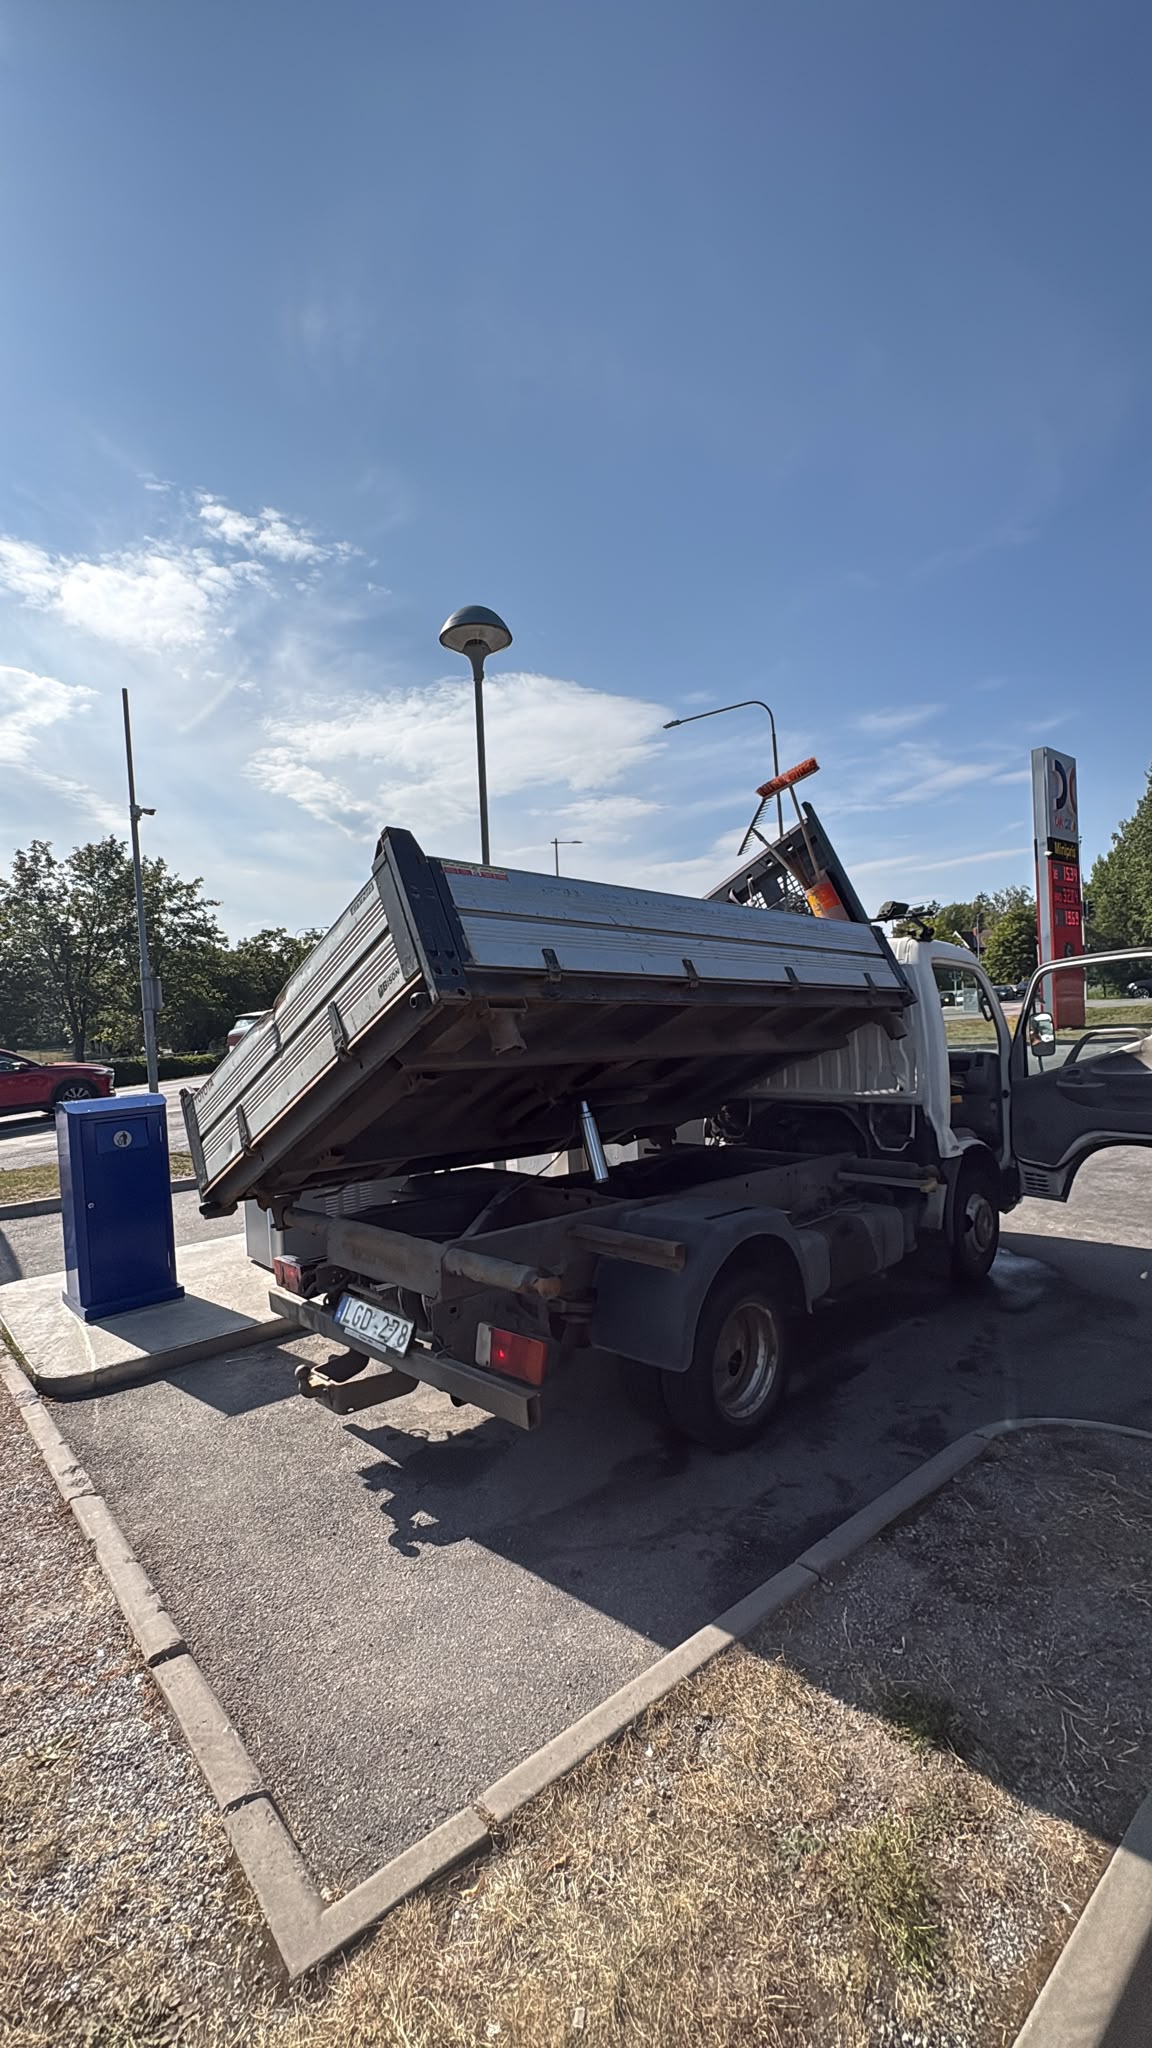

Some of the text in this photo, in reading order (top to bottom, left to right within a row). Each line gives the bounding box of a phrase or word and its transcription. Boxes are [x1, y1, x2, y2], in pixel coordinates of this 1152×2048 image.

[193, 1078, 215, 1105] TOYOTA
[342, 1299, 373, 1331] LGD
[378, 1315, 409, 1348] 278
